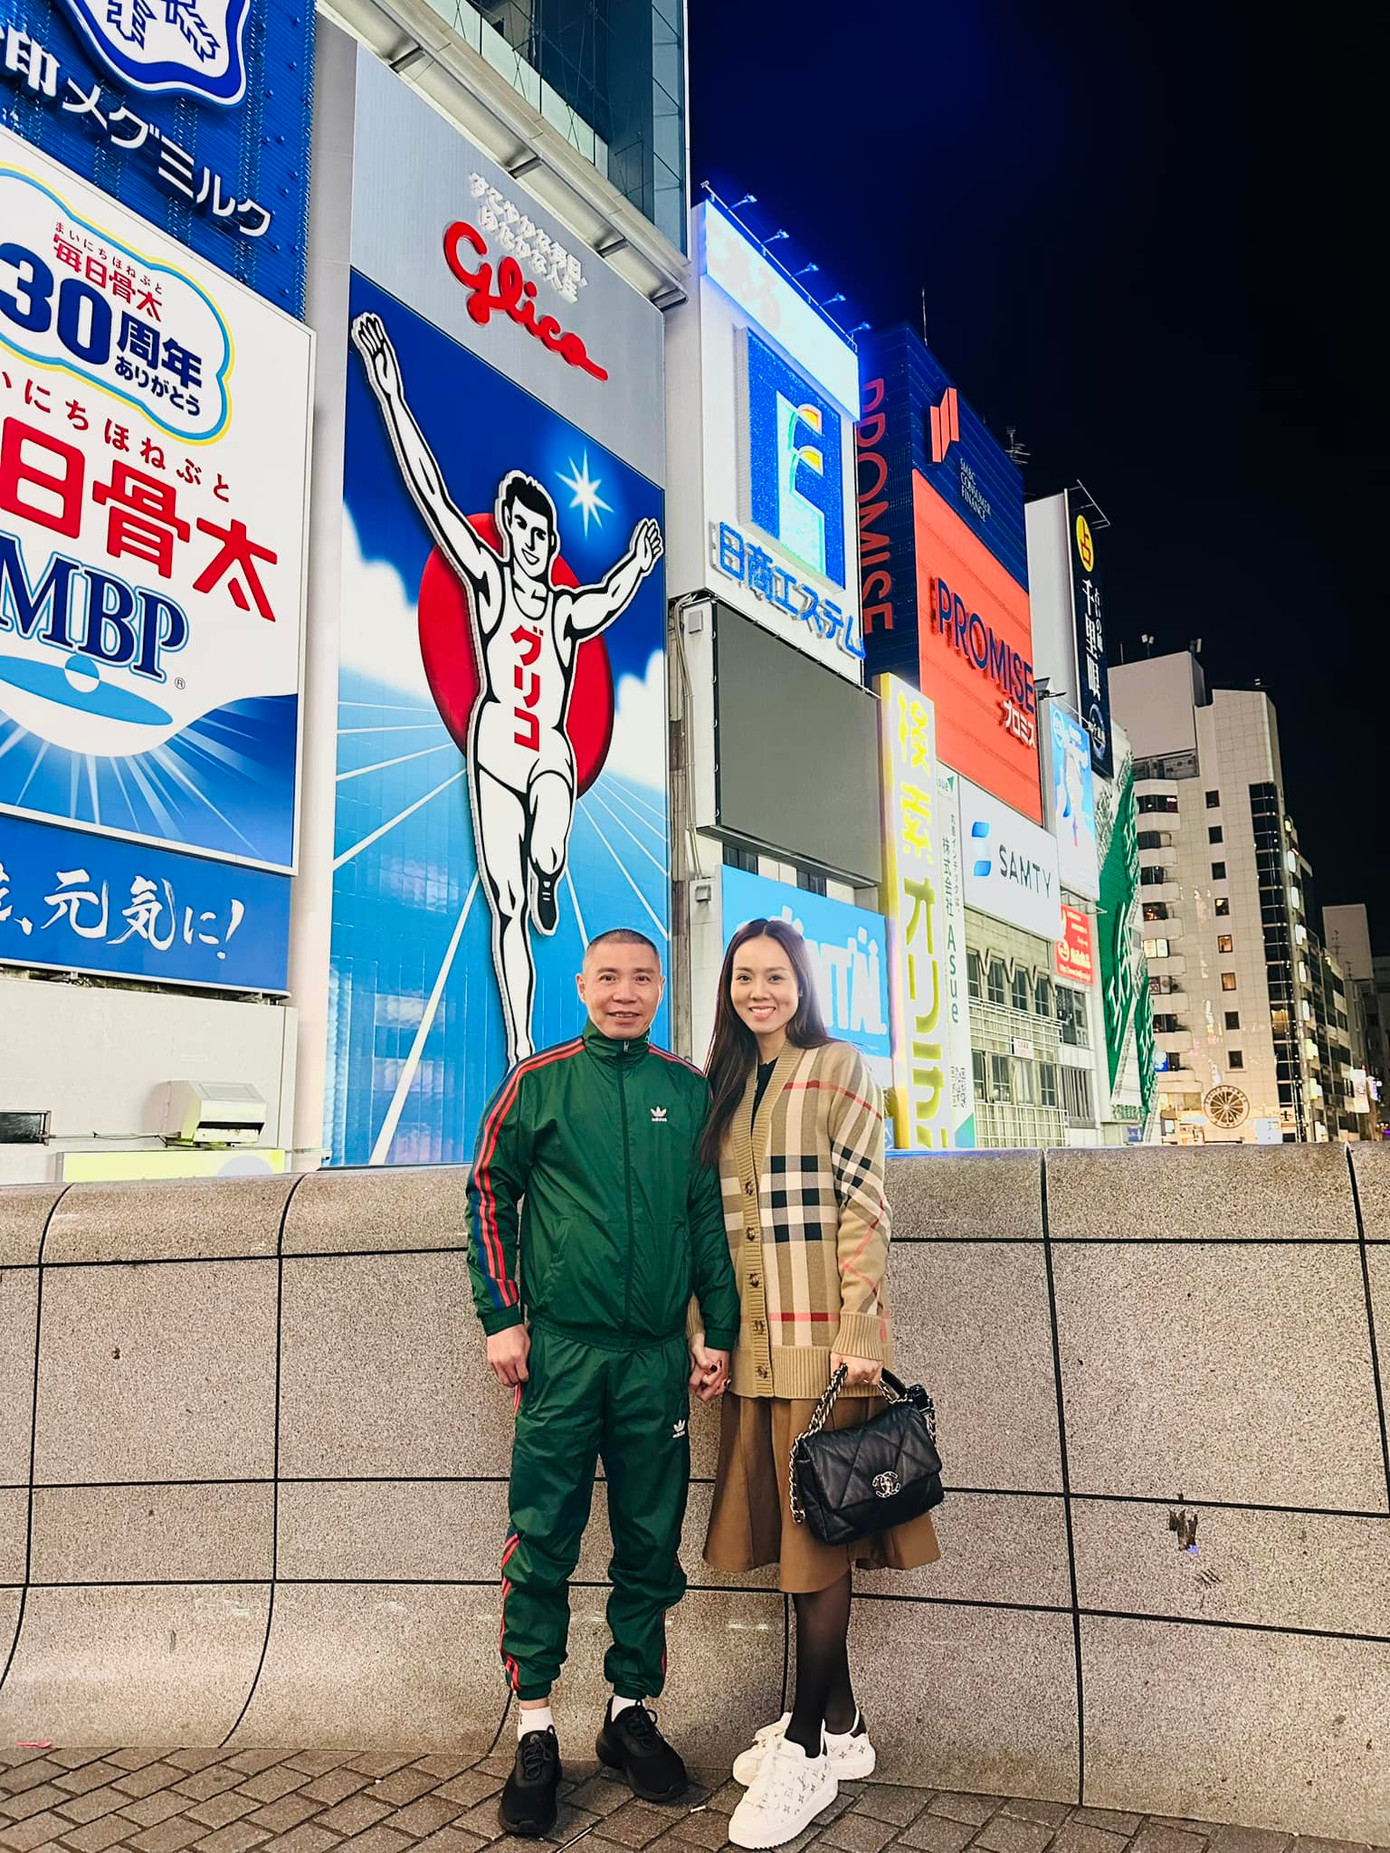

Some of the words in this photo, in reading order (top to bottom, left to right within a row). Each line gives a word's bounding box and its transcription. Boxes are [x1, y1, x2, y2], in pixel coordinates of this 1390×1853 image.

[0, 25, 271, 237] 印メグミルク
[53, 234, 163, 322] 毎日骨太
[55, 222, 163, 294] まいにちほねぶと
[443, 221, 608, 382] Glico
[114, 355, 201, 417] ありがとう
[0, 416, 278, 622] 日骨太
[0, 530, 190, 683] MBP
[937, 577, 1035, 715] PROMISE
[510, 624, 544, 752] グリコ
[1002, 700, 1036, 748] プロミス
[999, 844, 1051, 899] SAMTY
[947, 924, 959, 1024] Asue
